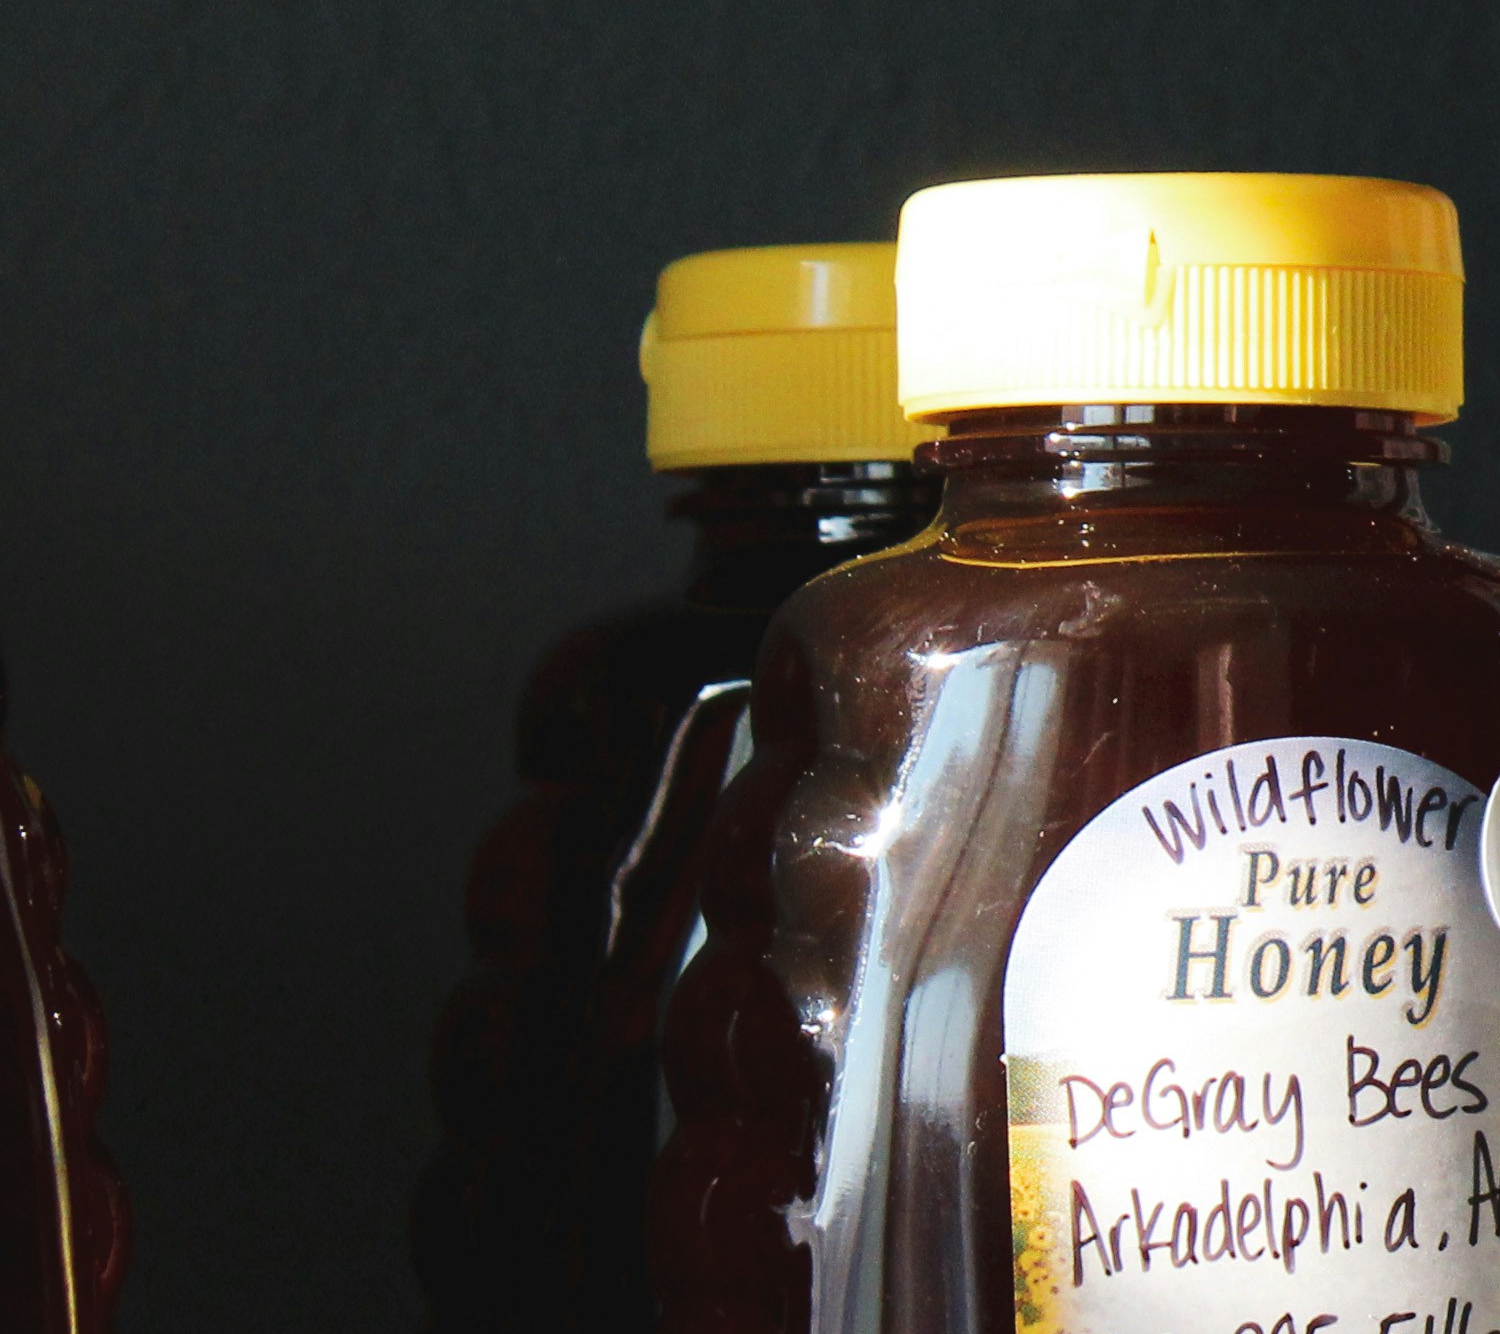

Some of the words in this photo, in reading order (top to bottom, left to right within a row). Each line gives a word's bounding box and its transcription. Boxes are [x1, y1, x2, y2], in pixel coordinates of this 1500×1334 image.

[1141, 748, 1482, 865] Wildflower
[1242, 848, 1378, 909] Pure
[1167, 912, 1449, 1024] Honey
[1059, 1059, 1304, 1169] DeGray
[1346, 1036, 1487, 1126] Bees
